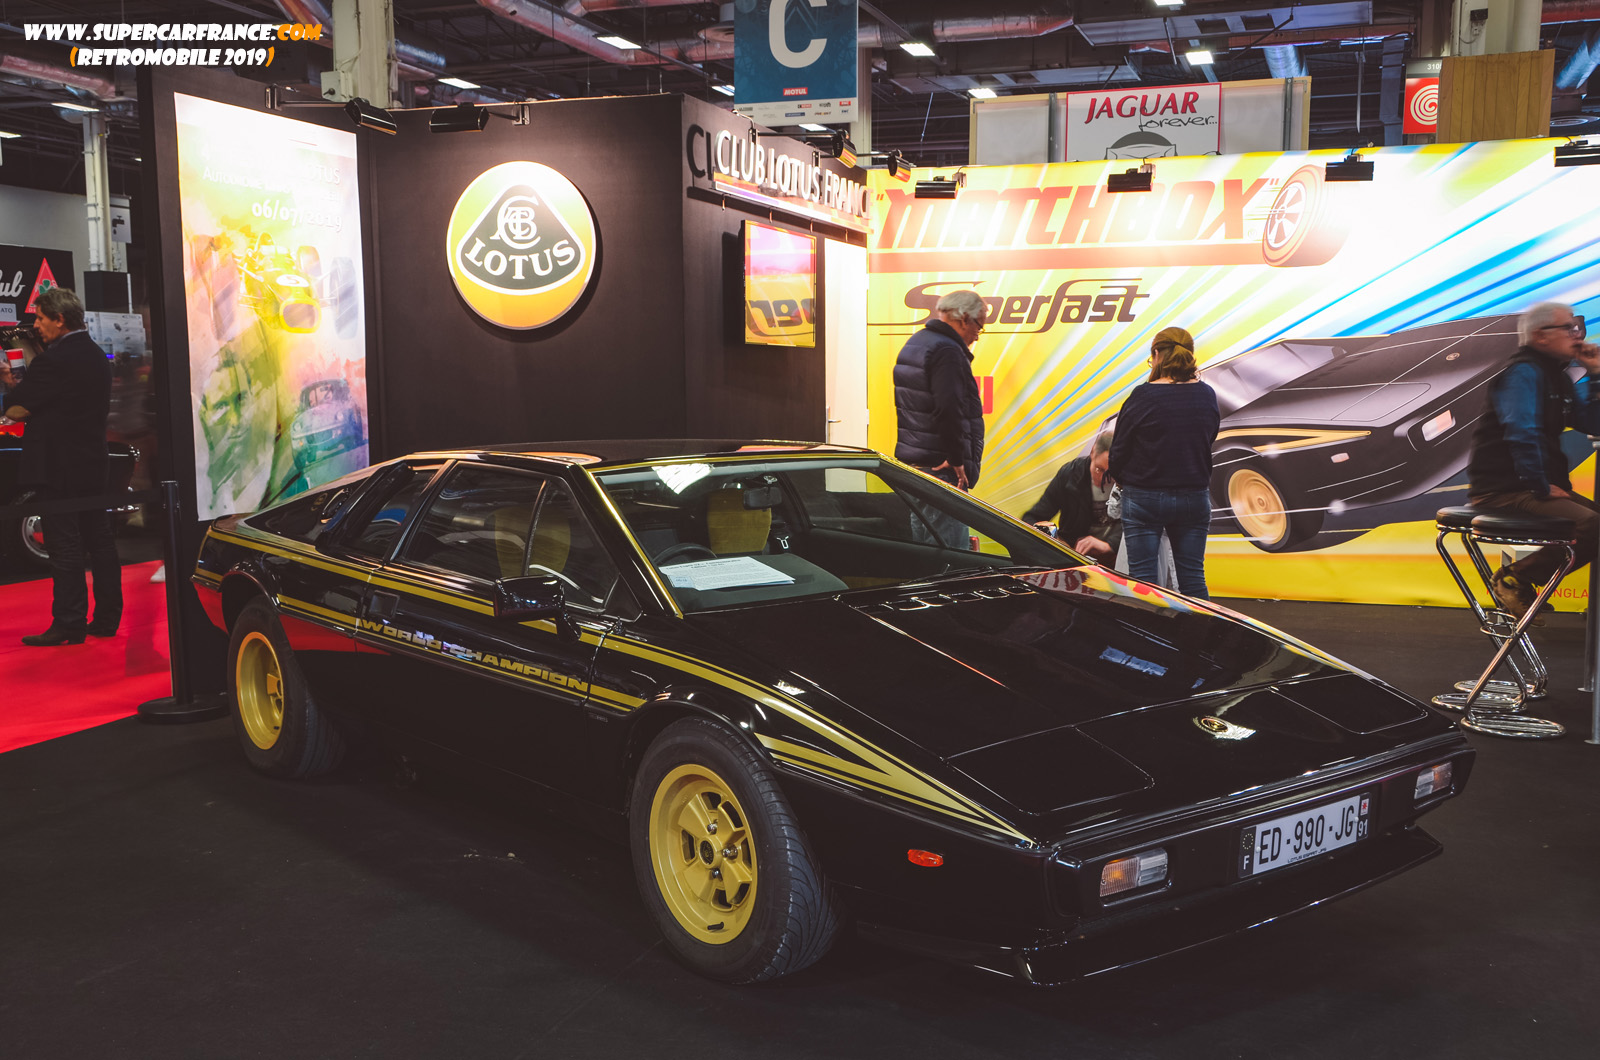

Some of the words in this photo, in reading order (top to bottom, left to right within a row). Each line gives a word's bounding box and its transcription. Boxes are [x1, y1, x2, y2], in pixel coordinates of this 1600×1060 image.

[768, 0, 828, 68] C
[1084, 91, 1199, 124] JAGUAR
[714, 129, 765, 185] CLUB
[767, 148, 820, 203] LOTUS
[465, 237, 576, 280] LOTUS
[867, 278, 1150, 334] Sperfast
[447, 643, 588, 693] CHAMPION
[1358, 819, 1368, 837] 91
[1243, 855, 1250, 870] F
